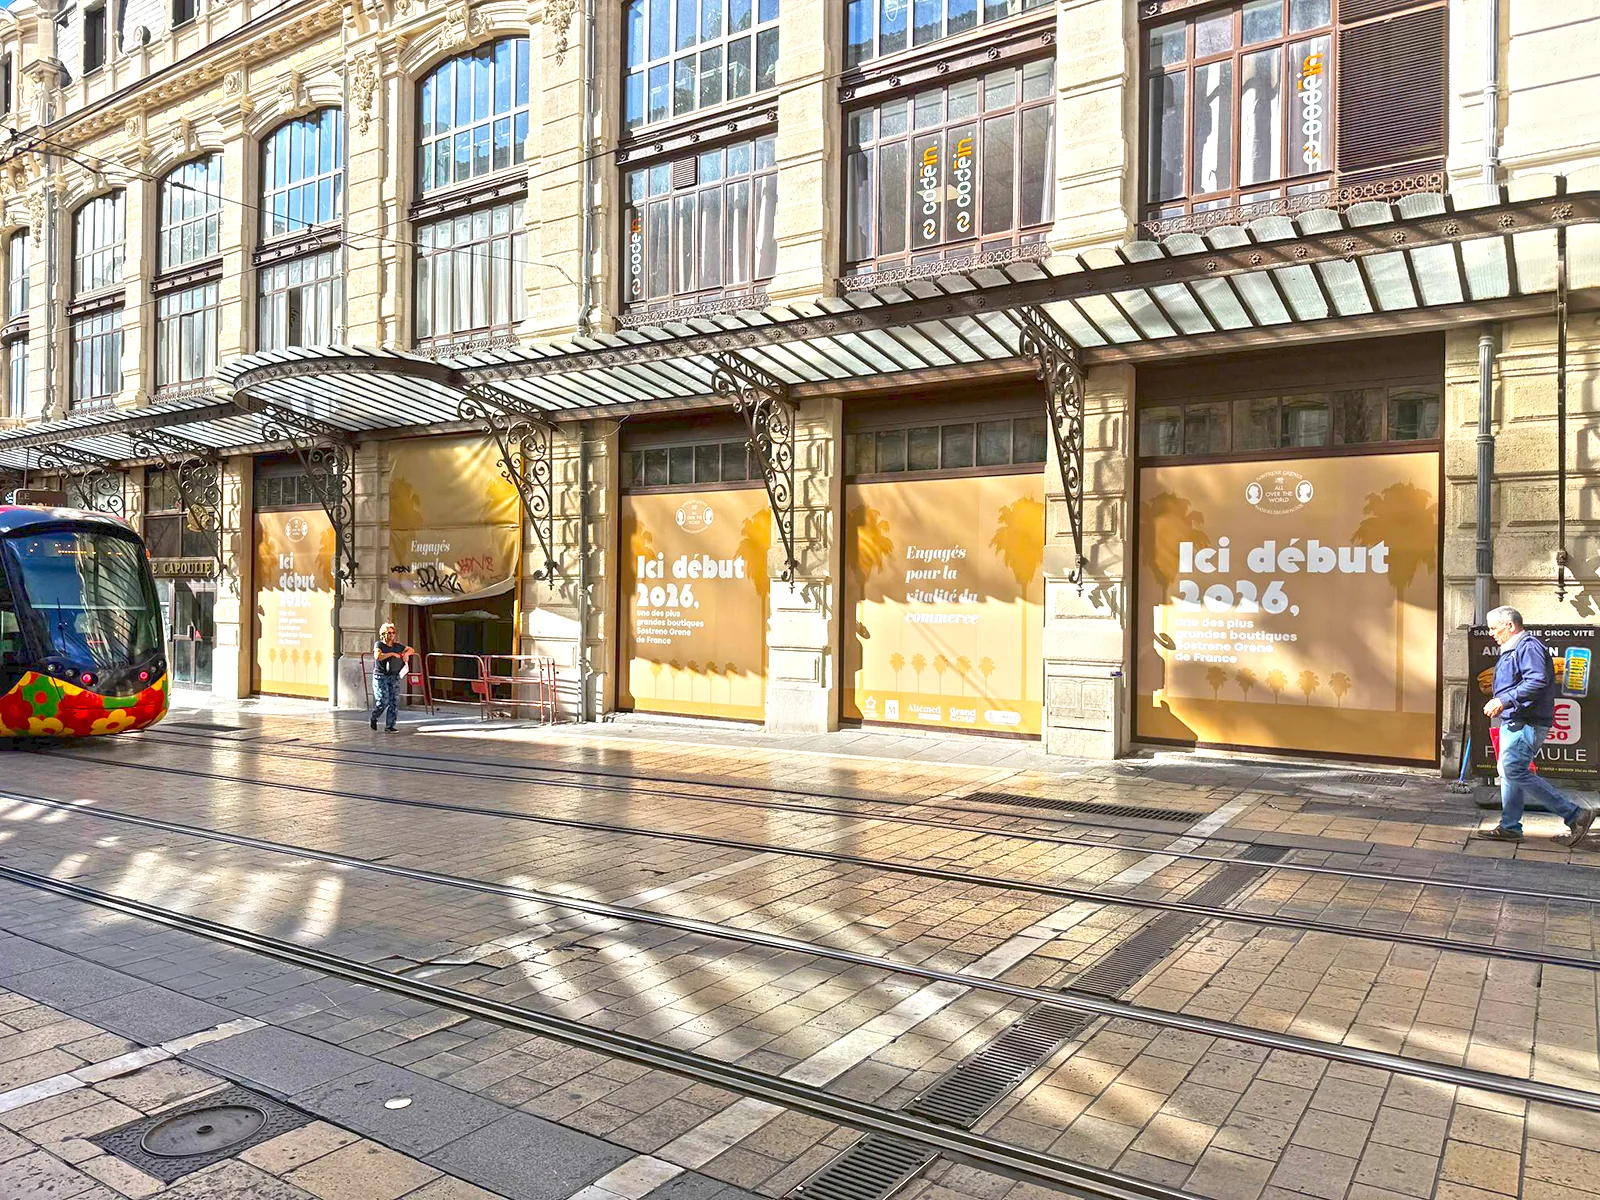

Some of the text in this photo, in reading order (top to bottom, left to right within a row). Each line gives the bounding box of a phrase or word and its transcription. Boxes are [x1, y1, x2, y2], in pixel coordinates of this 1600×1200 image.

[411, 540, 451, 556] Engagés
[906, 544, 967, 563] Engagés
[279, 551, 294, 570] Ici
[1179, 536, 1389, 574] Ici début
[163, 561, 212, 574] CAPOULIE
[637, 551, 745, 579] Ici début
[279, 571, 315, 589] début
[905, 565, 957, 584] pour la
[906, 588, 979, 603] vitalité du
[1177, 579, 1300, 617] 2026,
[651, 609, 664, 617] des
[665, 609, 681, 618] plus
[904, 612, 980, 625] commerce
[636, 618, 705, 628] grandes boutiques
[1175, 617, 1254, 630] une des plus
[669, 627, 692, 636] Grene
[1175, 630, 1298, 643] grandes boutiques
[646, 636, 672, 645] France
[1234, 642, 1274, 653] Grene
[1174, 652, 1238, 664] de France
